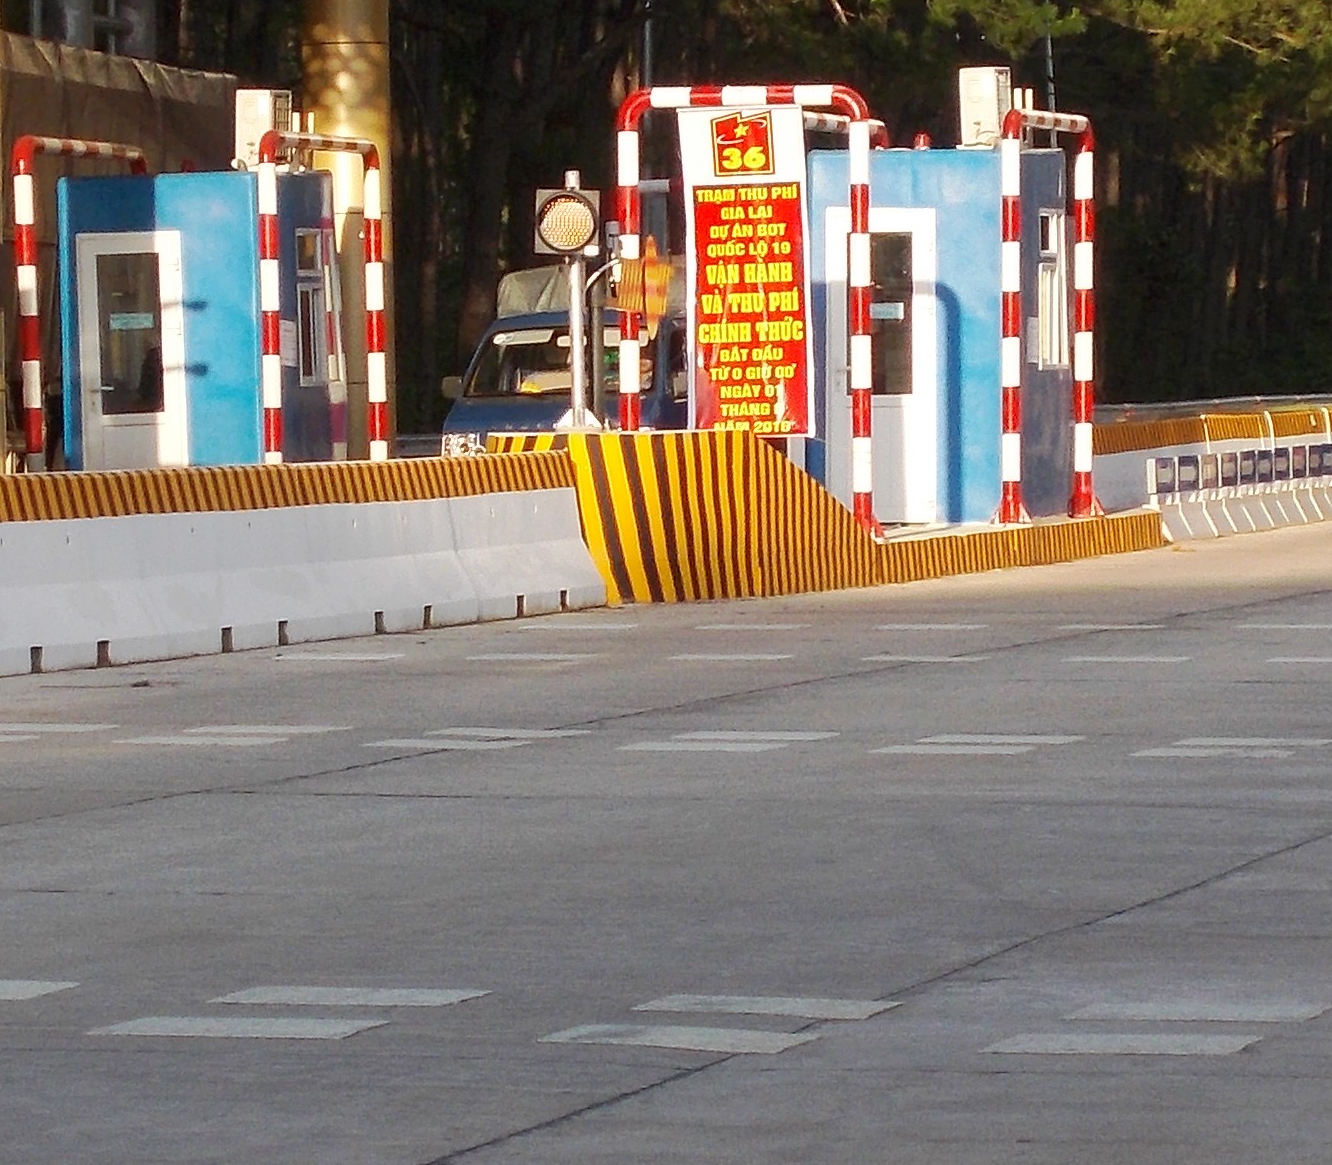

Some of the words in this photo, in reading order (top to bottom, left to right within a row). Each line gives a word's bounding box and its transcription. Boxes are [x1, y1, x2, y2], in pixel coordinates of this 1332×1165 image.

[721, 147, 766, 170] 36
[696, 188, 735, 204] TRẠM
[738, 187, 768, 201] THU
[771, 184, 798, 200] PHÍ
[721, 206, 745, 220] GIA
[748, 205, 773, 219] LAI
[732, 222, 753, 238] ÁN
[757, 223, 787, 237] BOT
[707, 240, 745, 258] QUỐC
[749, 239, 768, 258] LỘ
[771, 241, 791, 255] 19
[706, 260, 739, 288] VẬN
[744, 257, 793, 283] HÀNH
[701, 288, 723, 314] VÀ
[728, 292, 764, 313] THU
[768, 286, 799, 312] PHÍ
[698, 318, 752, 343] CHÍNH
[755, 315, 804, 342] THỨC
[720, 382, 761, 399] NGÀY
[719, 401, 771, 417] THÁNG
